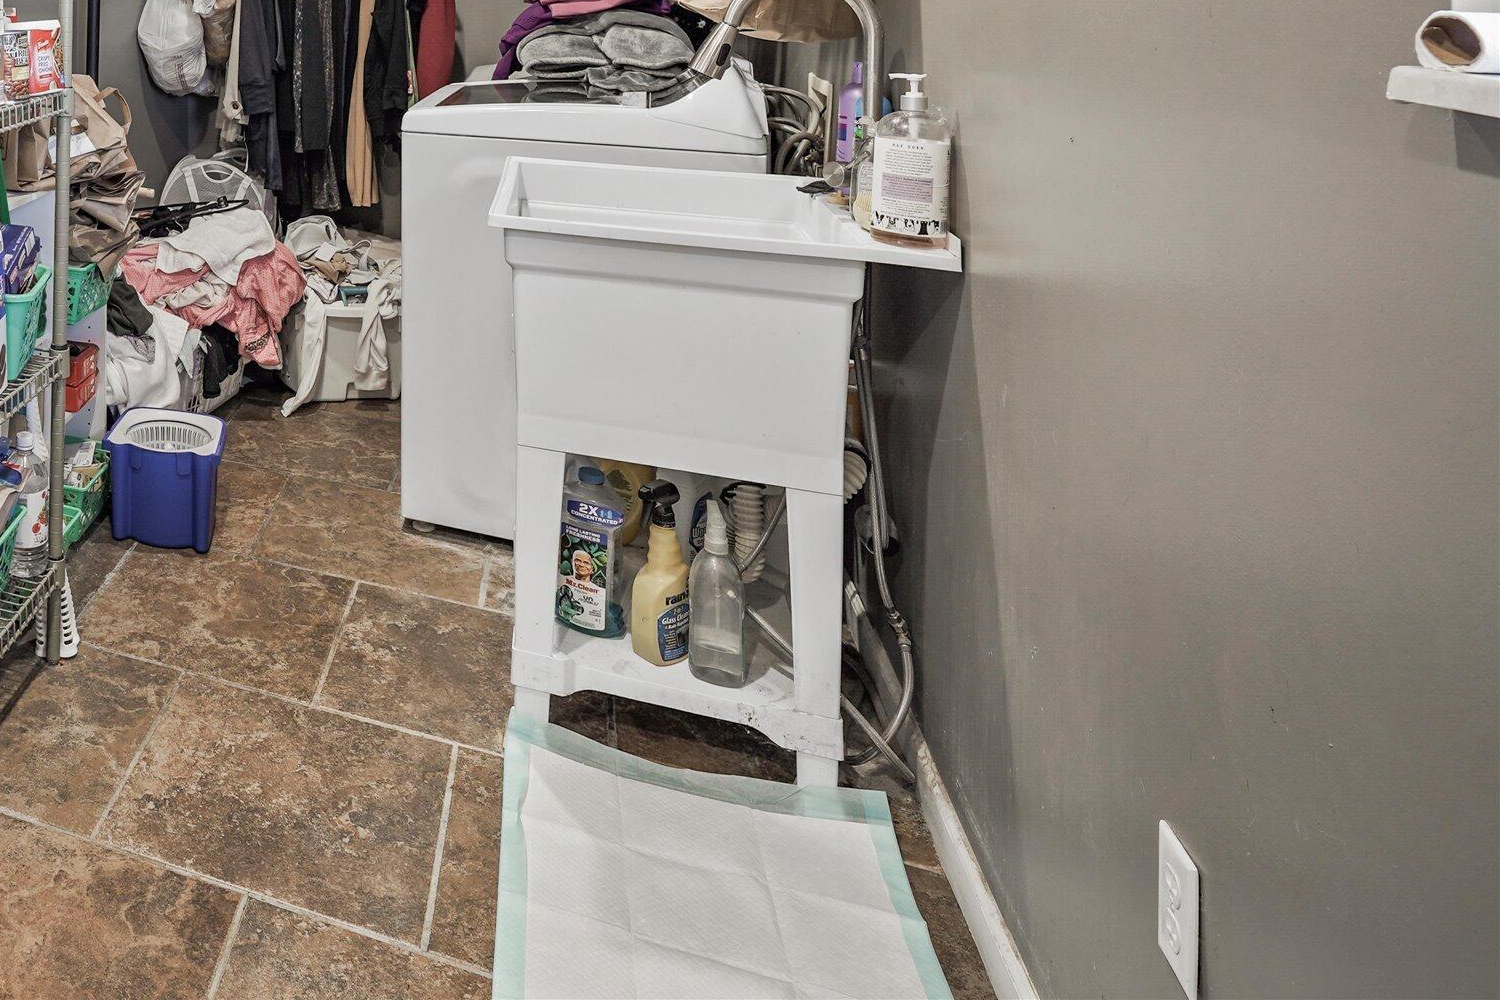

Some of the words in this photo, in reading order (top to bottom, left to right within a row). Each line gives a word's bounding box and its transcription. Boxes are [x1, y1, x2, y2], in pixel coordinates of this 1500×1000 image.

[579, 503, 599, 516] 2X
[570, 510, 618, 525] CONCENTRATED
[566, 525, 579, 533] LONG
[579, 529, 601, 538] LASTING
[566, 529, 601, 542] FRESHNESS
[566, 577, 578, 588] Mr.
[578, 582, 599, 594] Clean
[662, 615, 676, 626] Glass
